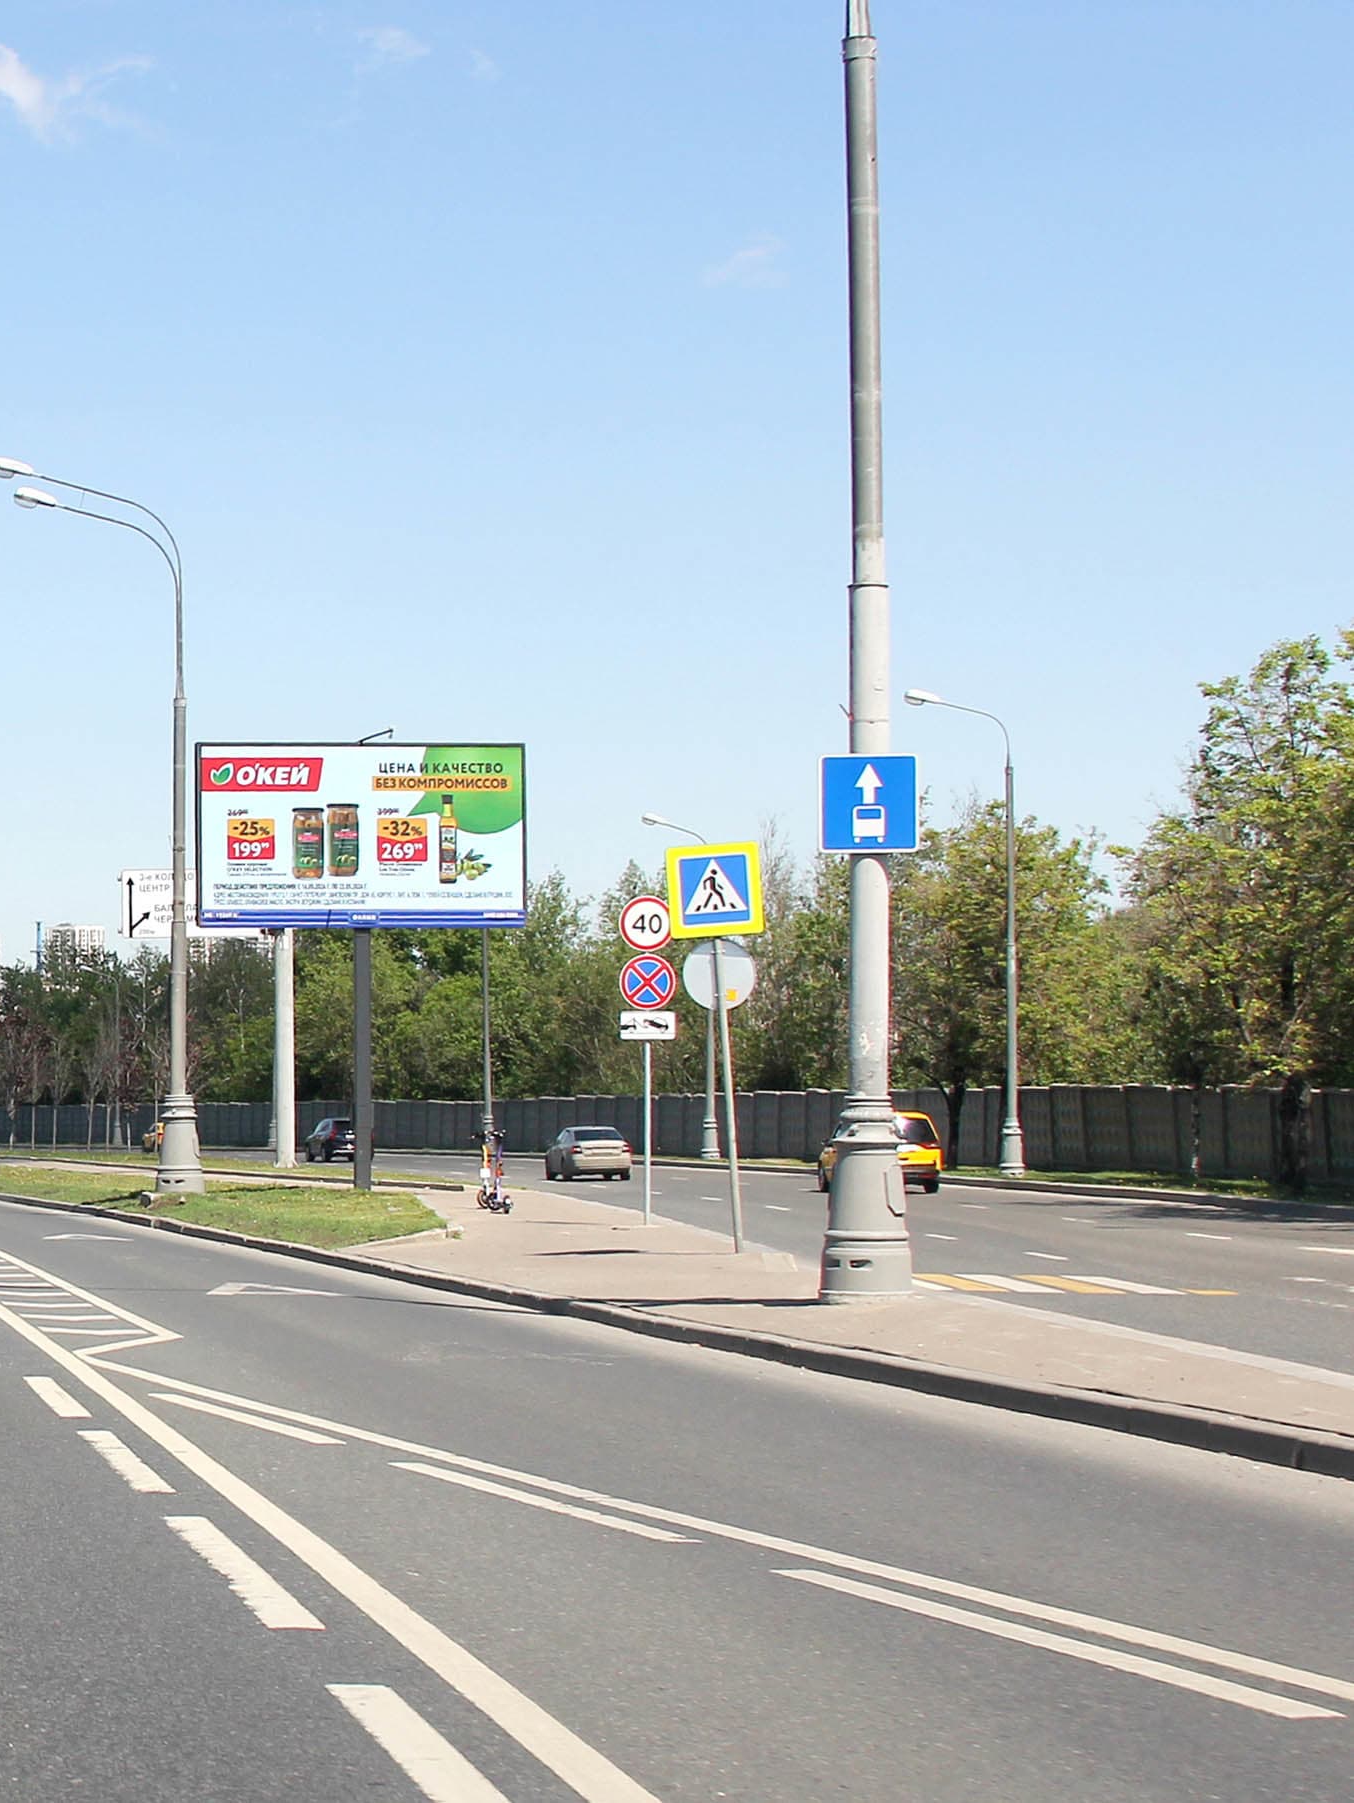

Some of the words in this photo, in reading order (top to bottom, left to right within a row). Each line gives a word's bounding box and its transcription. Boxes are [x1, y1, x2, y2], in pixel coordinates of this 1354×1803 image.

[378, 762, 415, 775] ЦЕНА
[419, 762, 429, 774] И
[432, 762, 504, 775] КАЧЕСТВО
[375, 778, 397, 789] БЕЗ
[398, 778, 508, 789] КОМПРОМИССОВ
[232, 821, 270, 836] -25%
[382, 820, 423, 837] -32%
[139, 884, 170, 893] ЦЕНТР
[632, 914, 662, 934] 40
